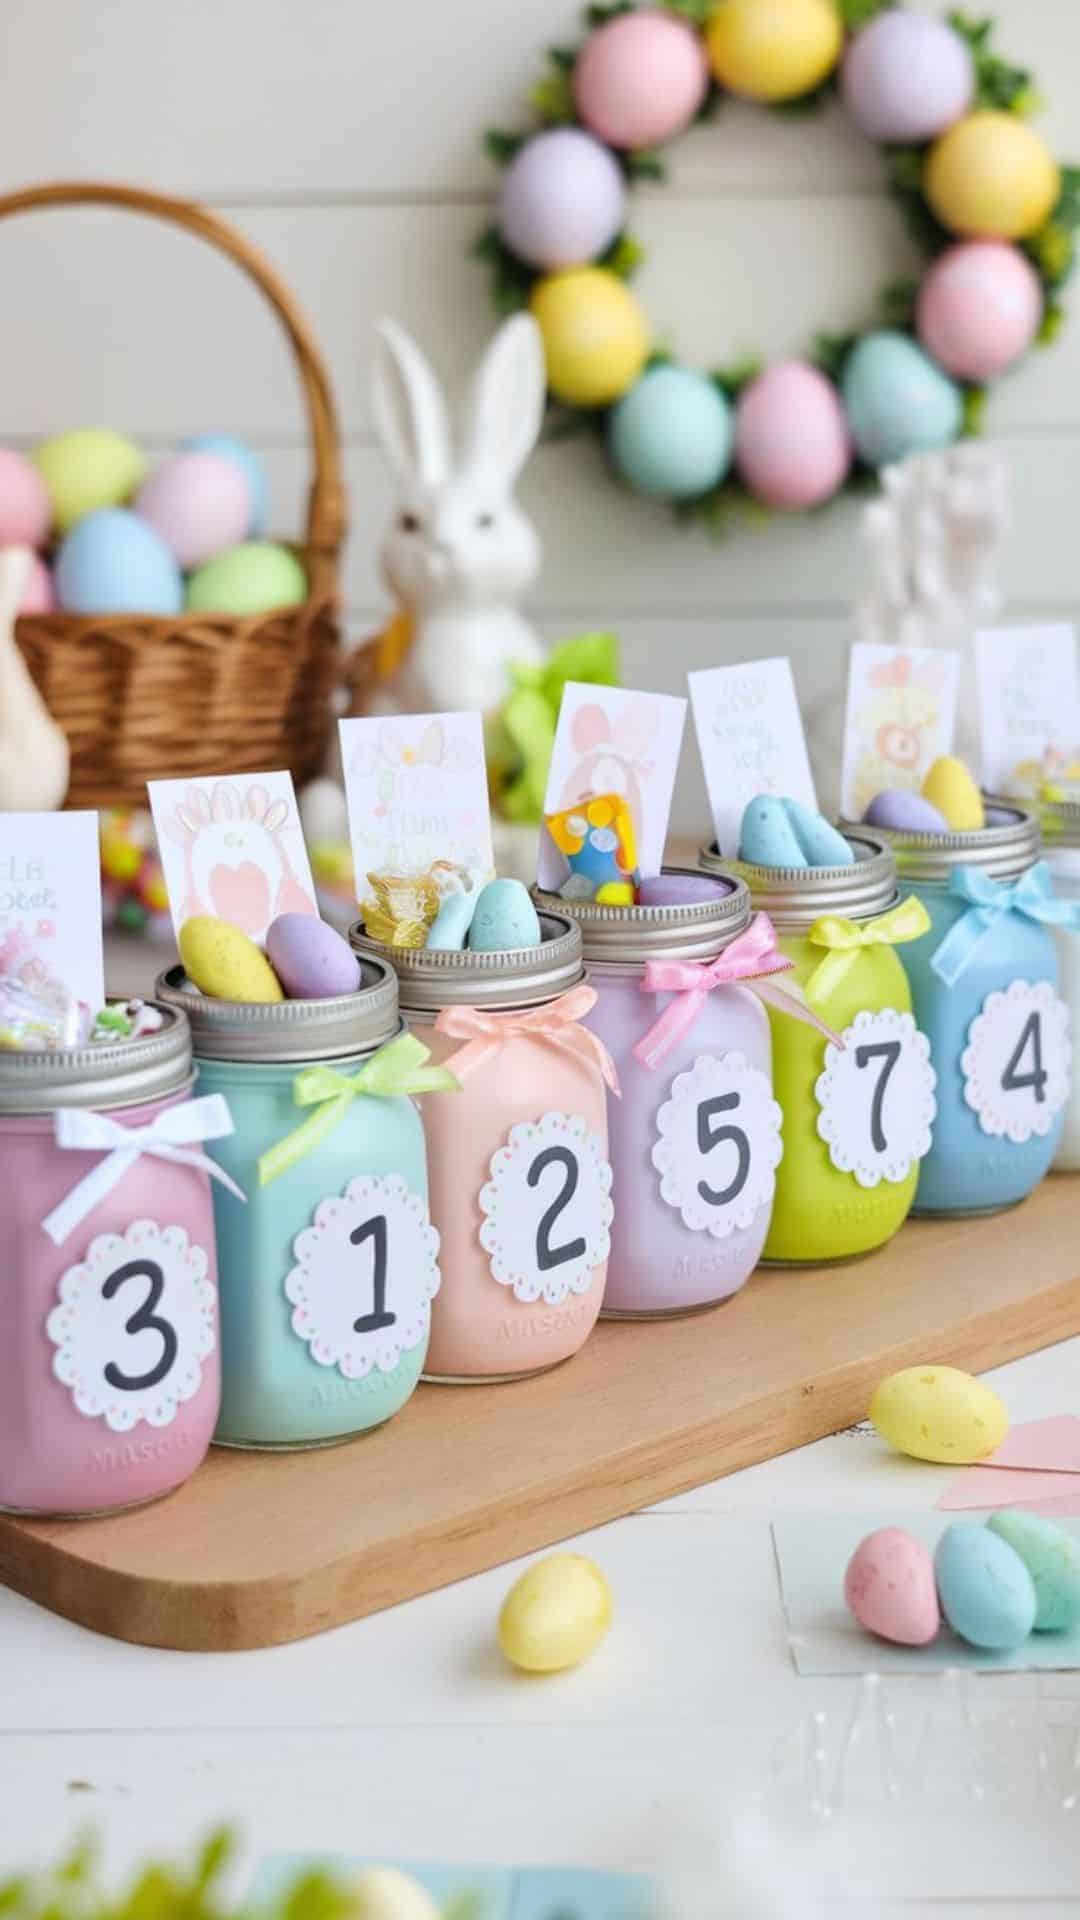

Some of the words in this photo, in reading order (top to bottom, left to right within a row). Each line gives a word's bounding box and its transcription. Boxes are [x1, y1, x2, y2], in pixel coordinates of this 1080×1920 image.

[855, 1041, 902, 1152] 7
[1001, 1010, 1048, 1103] 4
[697, 1092, 751, 1206] 5
[526, 1146, 587, 1271] 2
[101, 1259, 178, 1392] 3
[349, 1215, 396, 1334] 1
